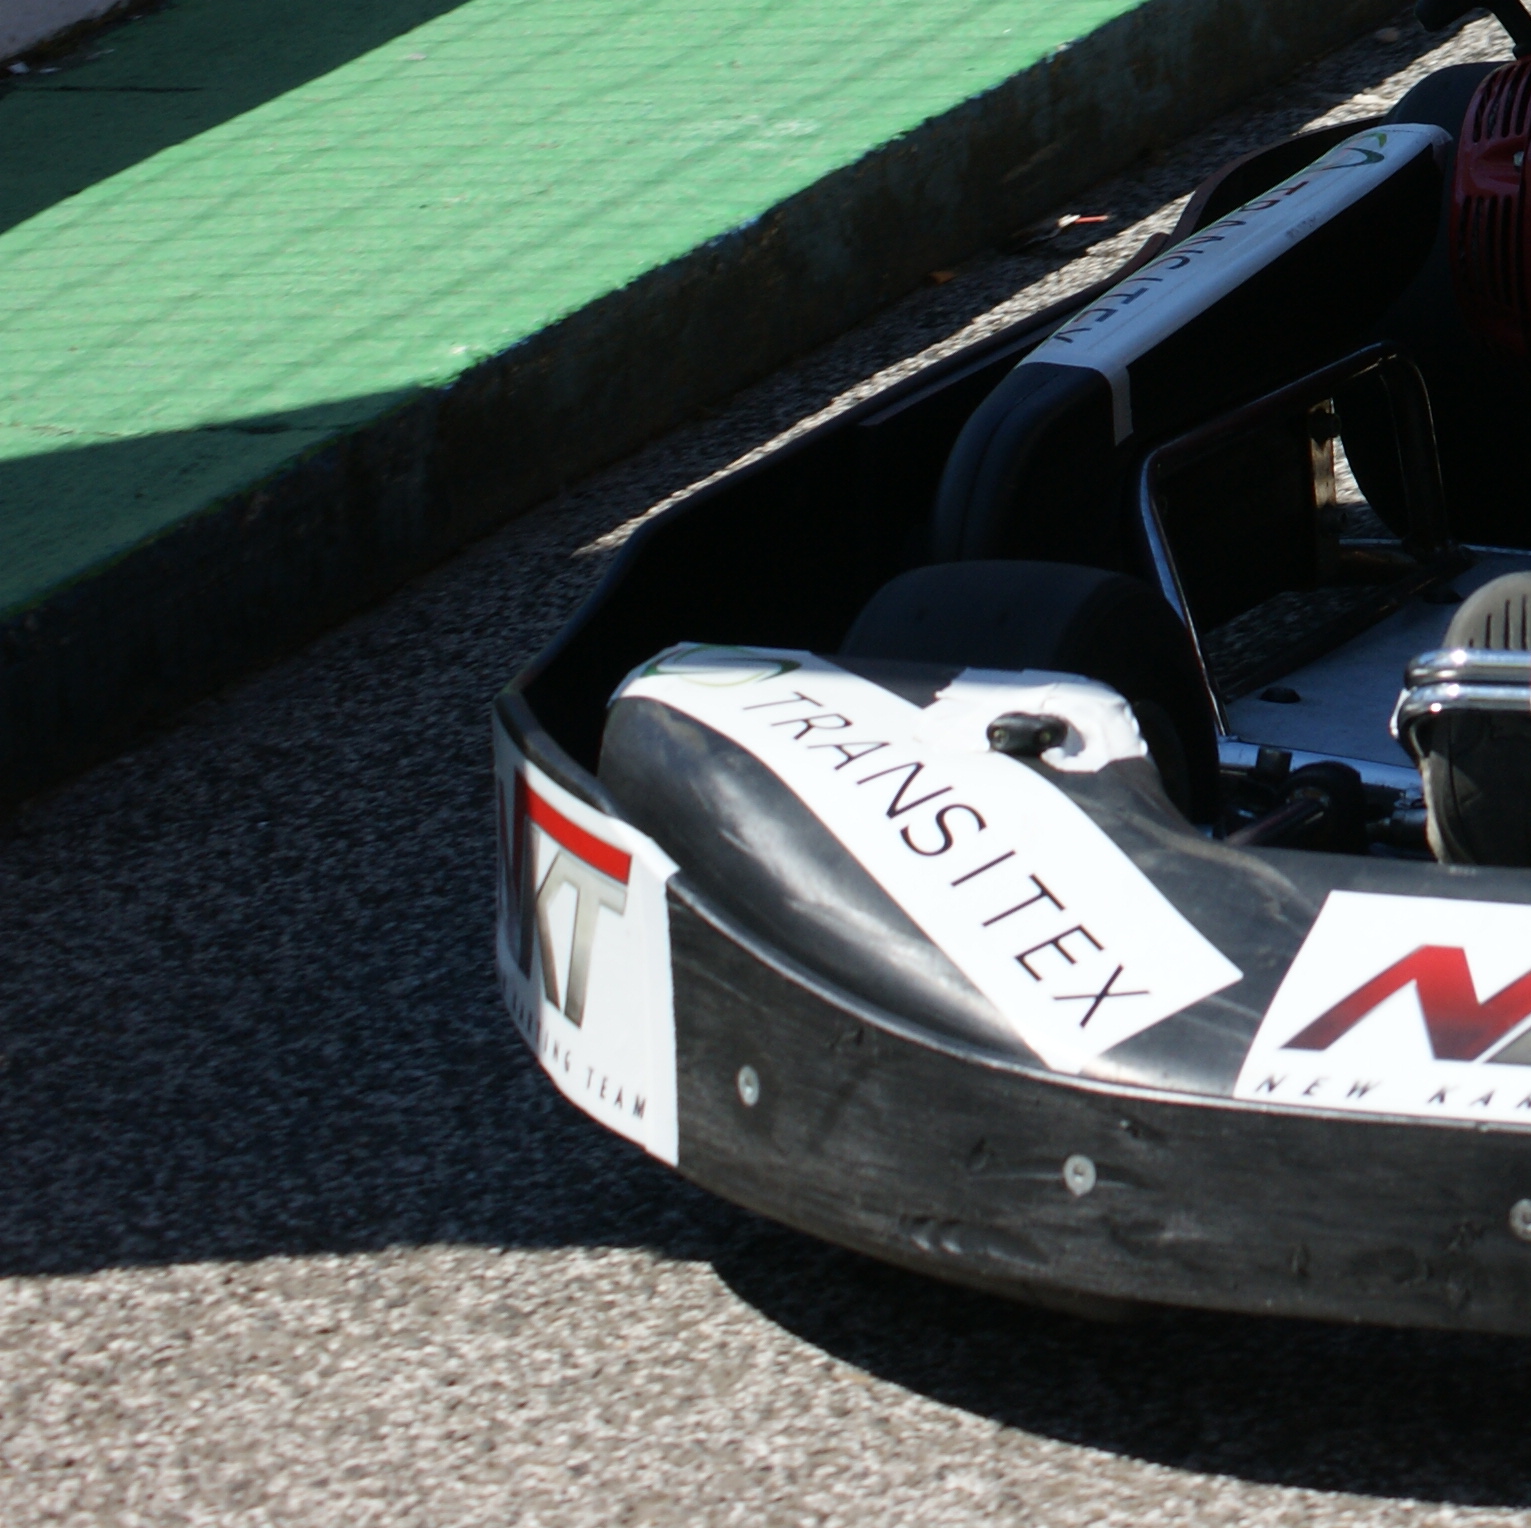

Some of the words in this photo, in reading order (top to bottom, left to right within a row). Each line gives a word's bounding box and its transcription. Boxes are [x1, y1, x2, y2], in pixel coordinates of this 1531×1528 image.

[742, 691, 1152, 1028] TRANSITEX
[586, 1066, 649, 1121] TEAM
[1255, 1074, 1381, 1099] NEW
